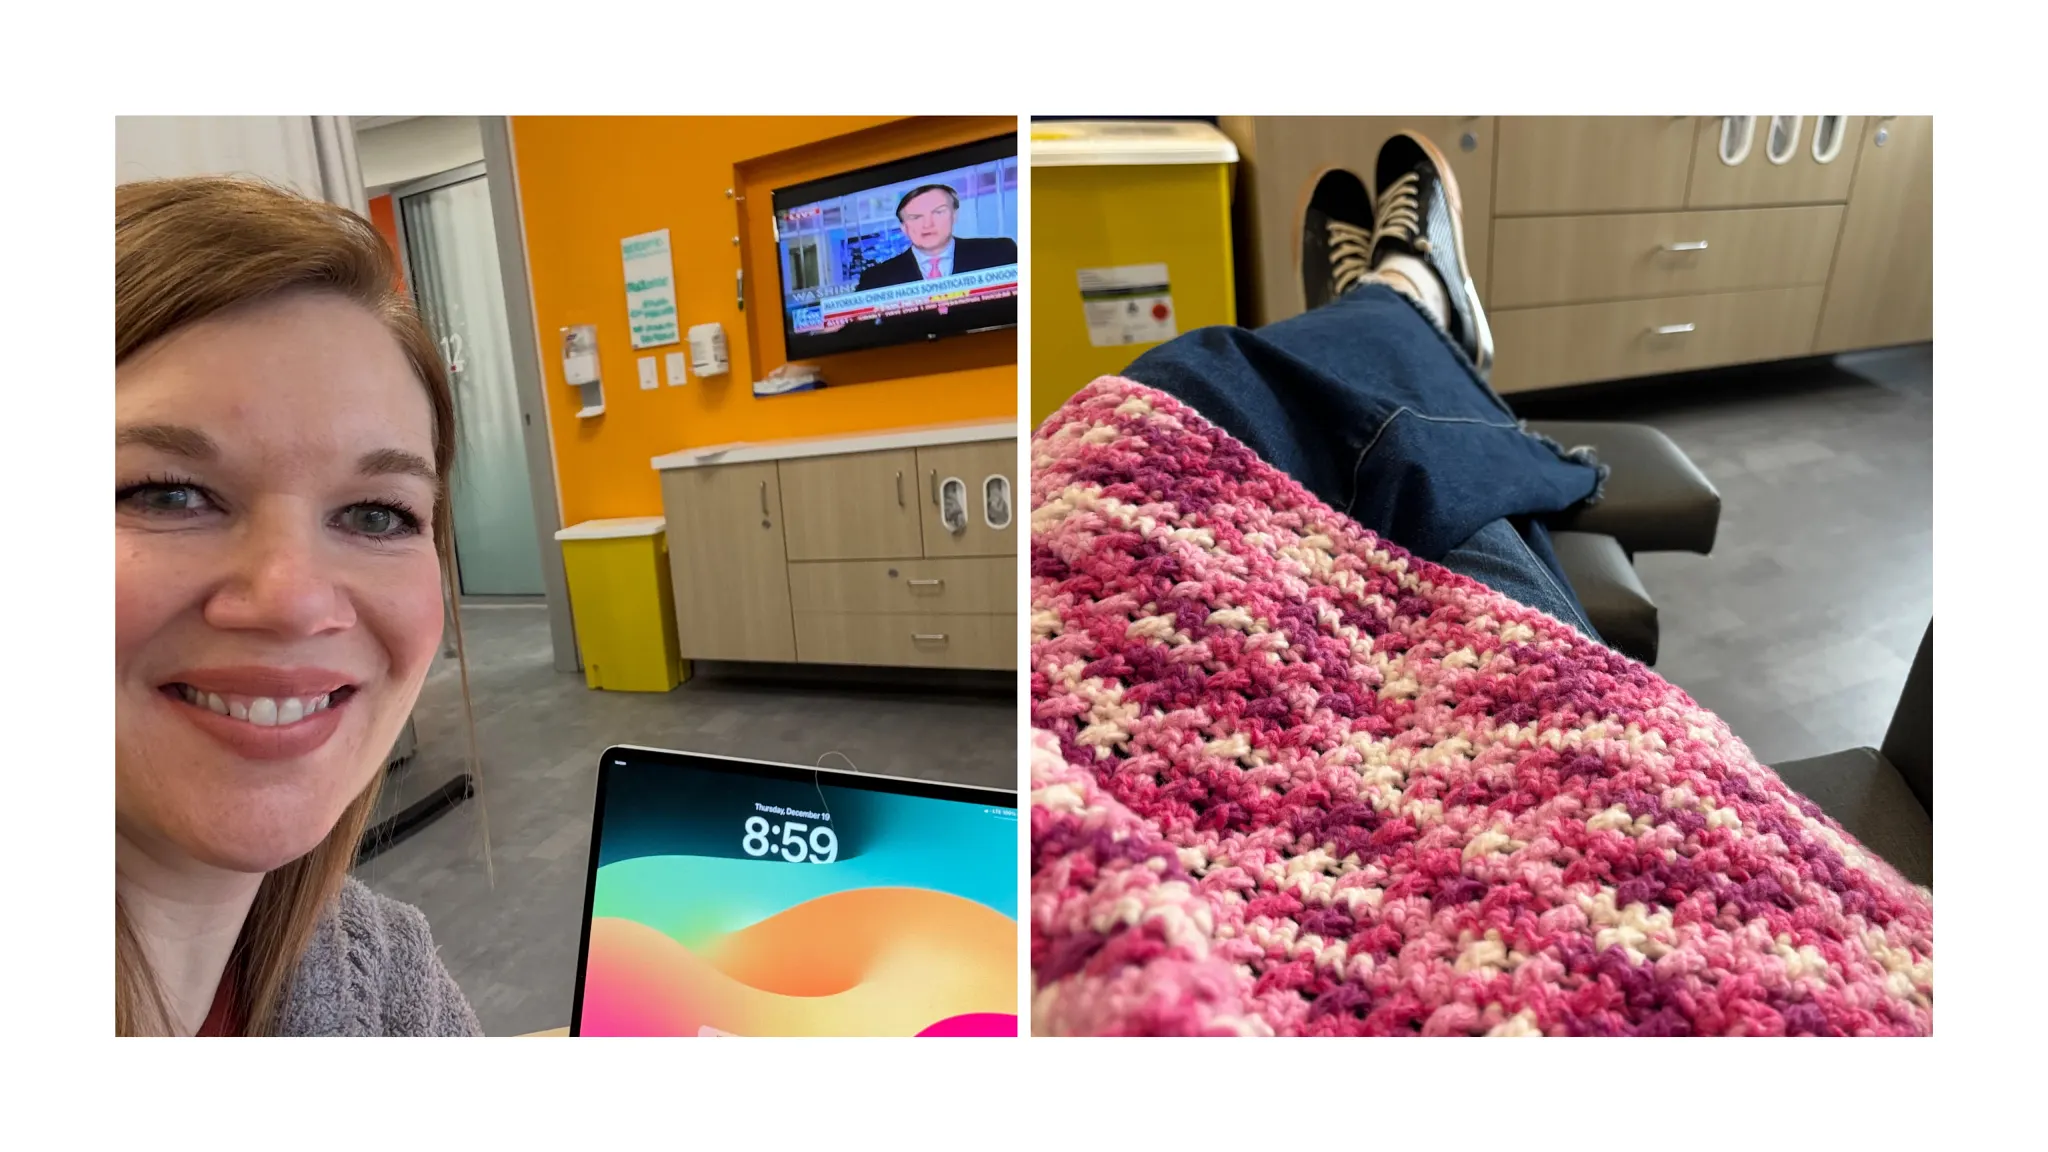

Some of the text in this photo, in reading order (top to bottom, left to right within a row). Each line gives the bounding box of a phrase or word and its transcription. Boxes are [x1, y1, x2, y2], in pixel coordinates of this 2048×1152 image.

[864, 289, 894, 304] CHINESE
[895, 284, 920, 298] HACKS
[920, 274, 977, 294] SOPHISTICATED
[440, 333, 465, 365] 12
[755, 802, 831, 821] Thursday, December 19
[742, 815, 839, 864] 8:59
